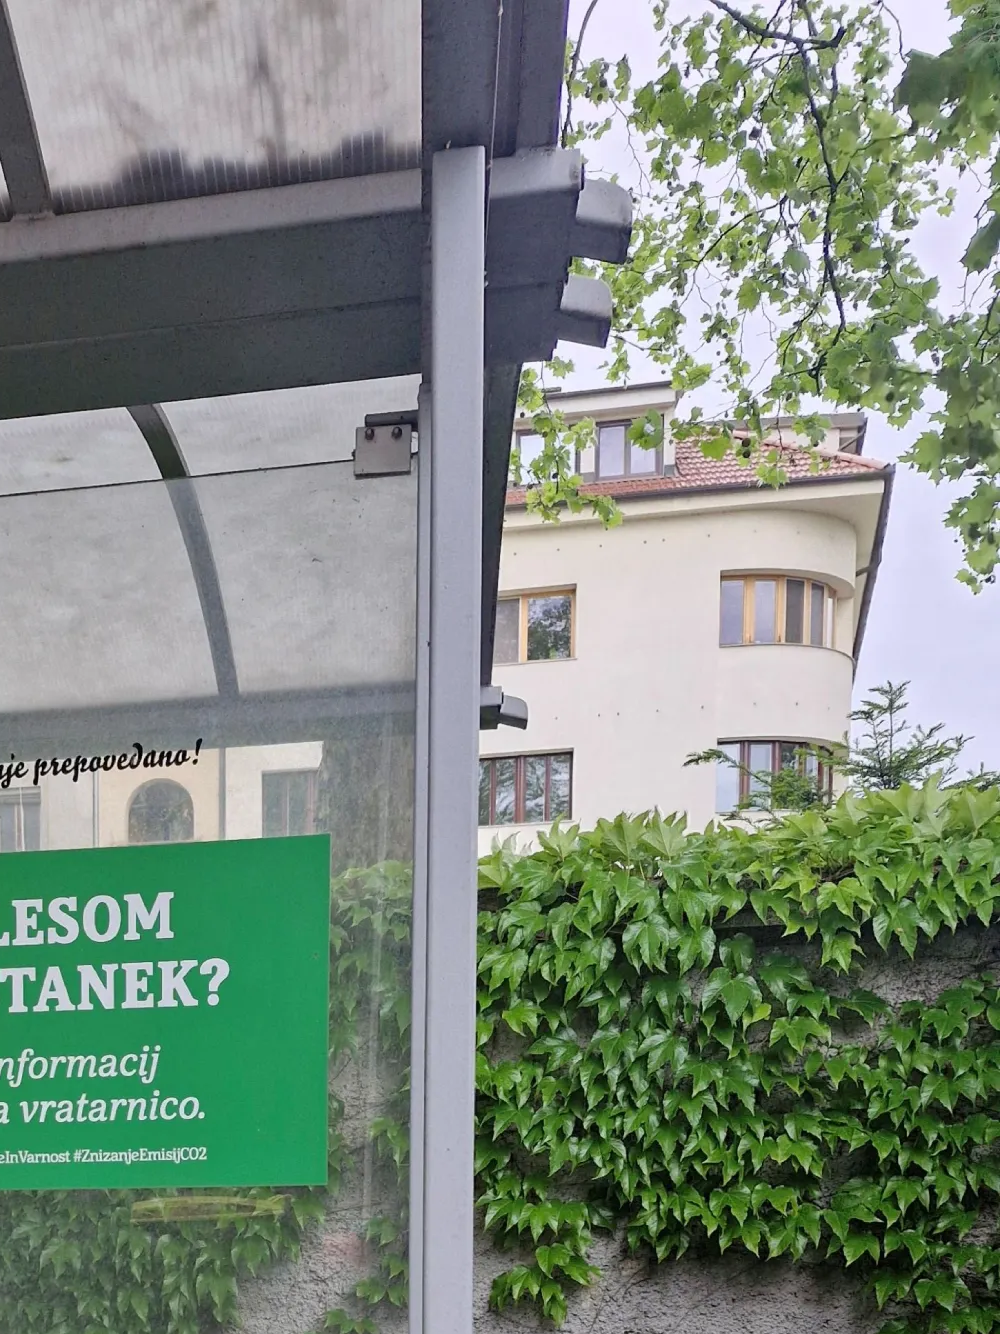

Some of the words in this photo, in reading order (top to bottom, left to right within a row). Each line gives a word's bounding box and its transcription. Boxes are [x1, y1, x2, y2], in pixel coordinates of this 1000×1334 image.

[33, 738, 203, 786] prepovedano!
[19, 1089, 206, 1123] vratarnico.
[72, 1146, 208, 1165] #ZnizanjeEmisijCO2
